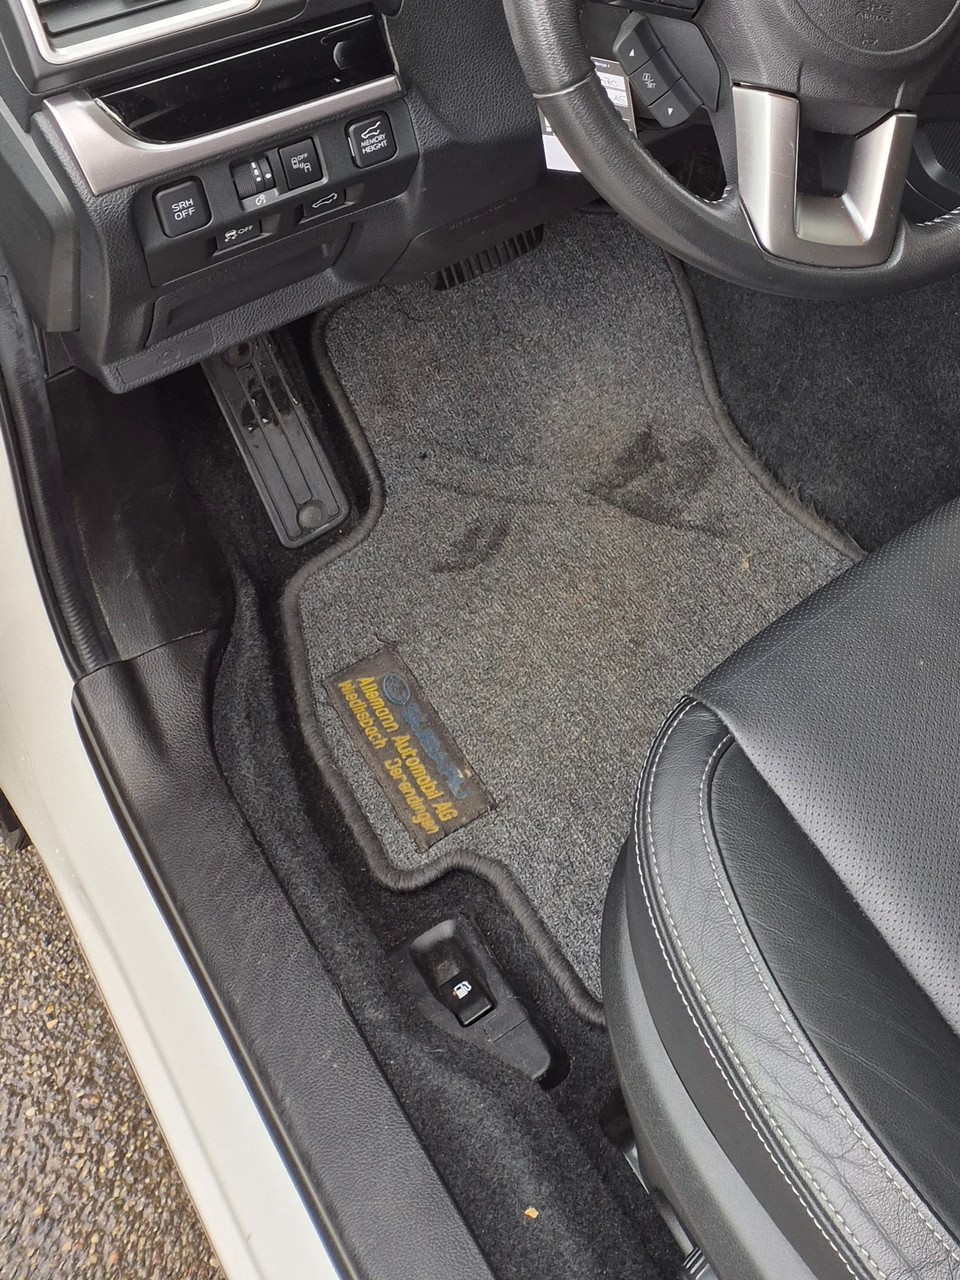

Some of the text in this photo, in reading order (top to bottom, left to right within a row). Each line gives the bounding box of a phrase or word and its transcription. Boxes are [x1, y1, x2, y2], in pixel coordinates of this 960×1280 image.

[360, 133, 386, 147] MEMORY
[362, 140, 388, 154] HEIGHT
[297, 152, 308, 160] OFF
[171, 198, 194, 212] SRH
[174, 206, 196, 221] OFF
[238, 224, 253, 235] OFF
[357, 676, 399, 733] Allemann
[391, 733, 444, 801] Automobil
[432, 801, 459, 823] AG
